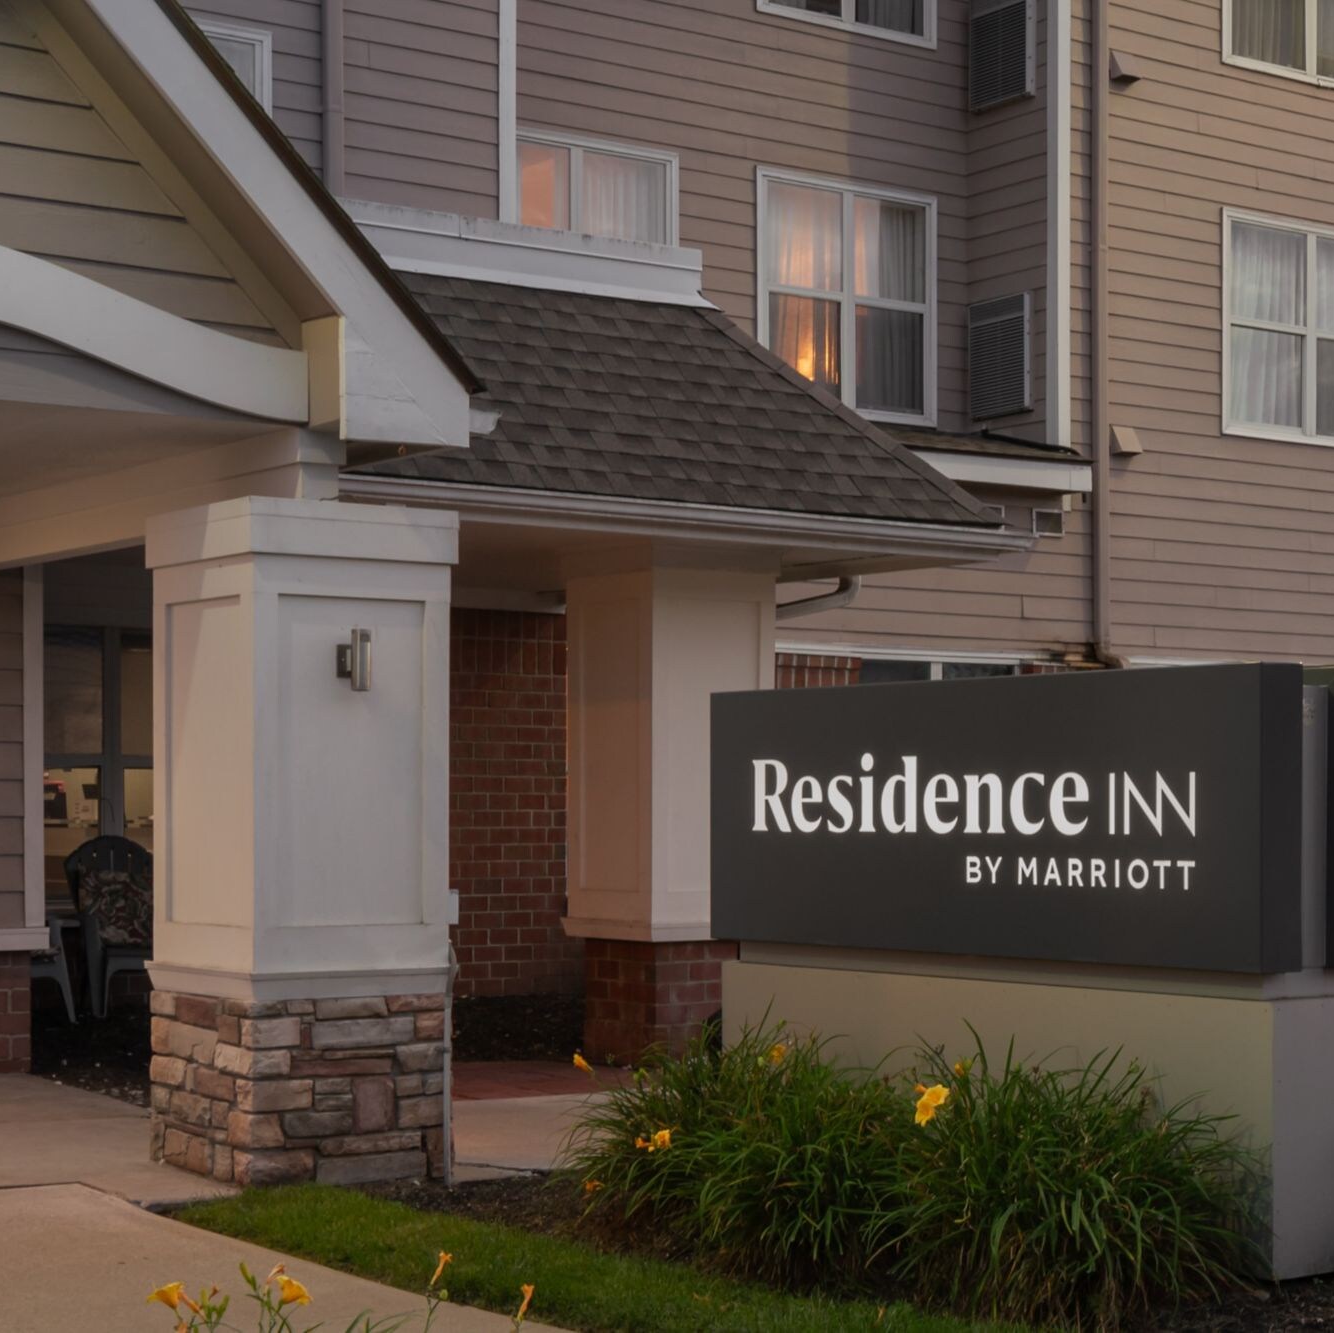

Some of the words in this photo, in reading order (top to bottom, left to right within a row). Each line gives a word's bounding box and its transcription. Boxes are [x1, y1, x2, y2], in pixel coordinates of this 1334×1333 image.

[751, 752, 1090, 836] Residence
[1108, 770, 1196, 837] INN
[965, 855, 1003, 885] BY
[1017, 857, 1196, 891] MARRIOTT
